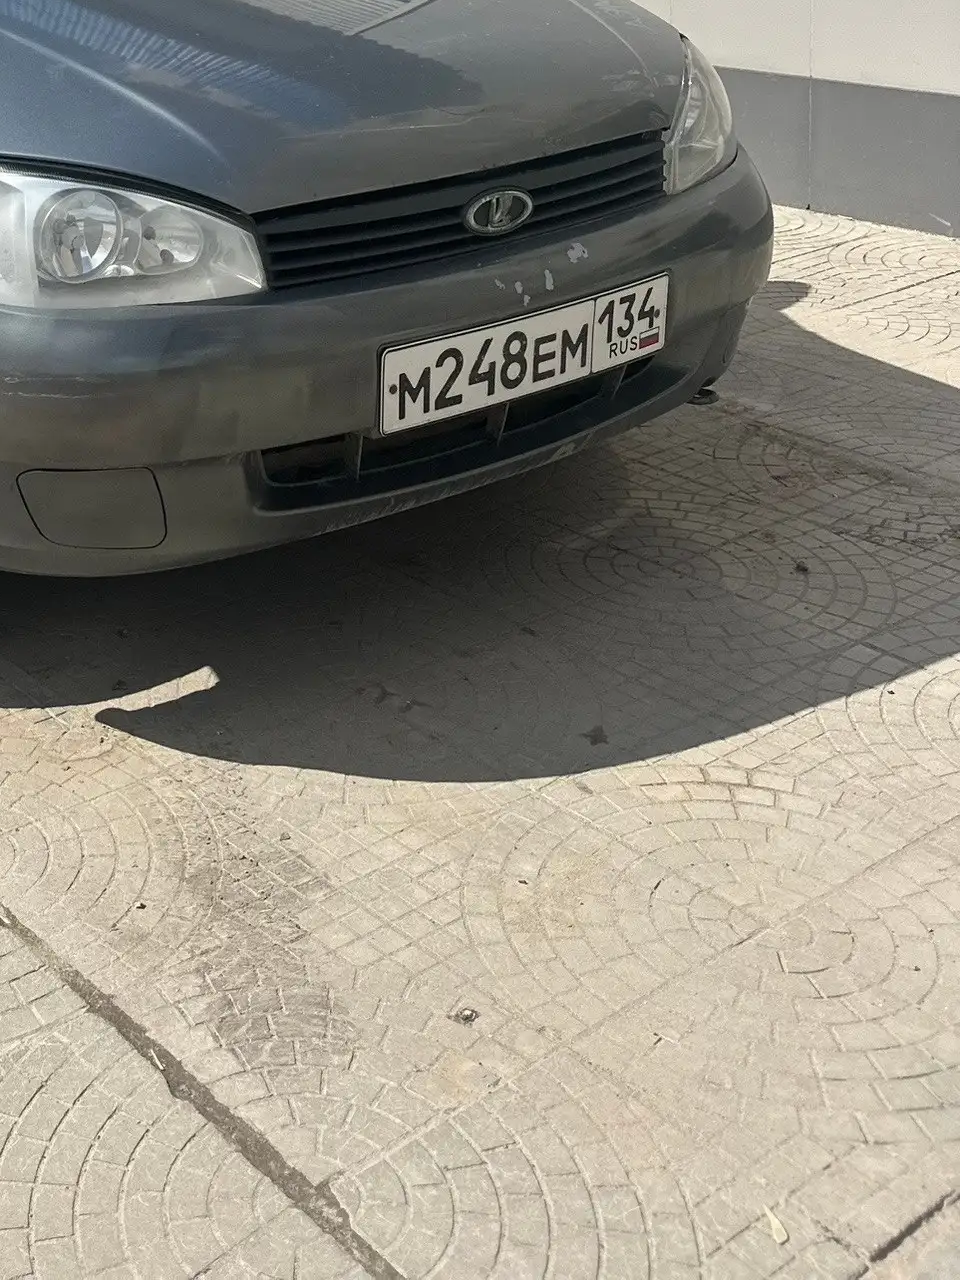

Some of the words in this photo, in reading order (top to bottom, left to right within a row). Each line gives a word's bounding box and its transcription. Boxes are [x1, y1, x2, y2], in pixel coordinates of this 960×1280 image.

[398, 322, 589, 420] M248EM
[597, 286, 655, 343] 134
[609, 335, 638, 358] RUS
